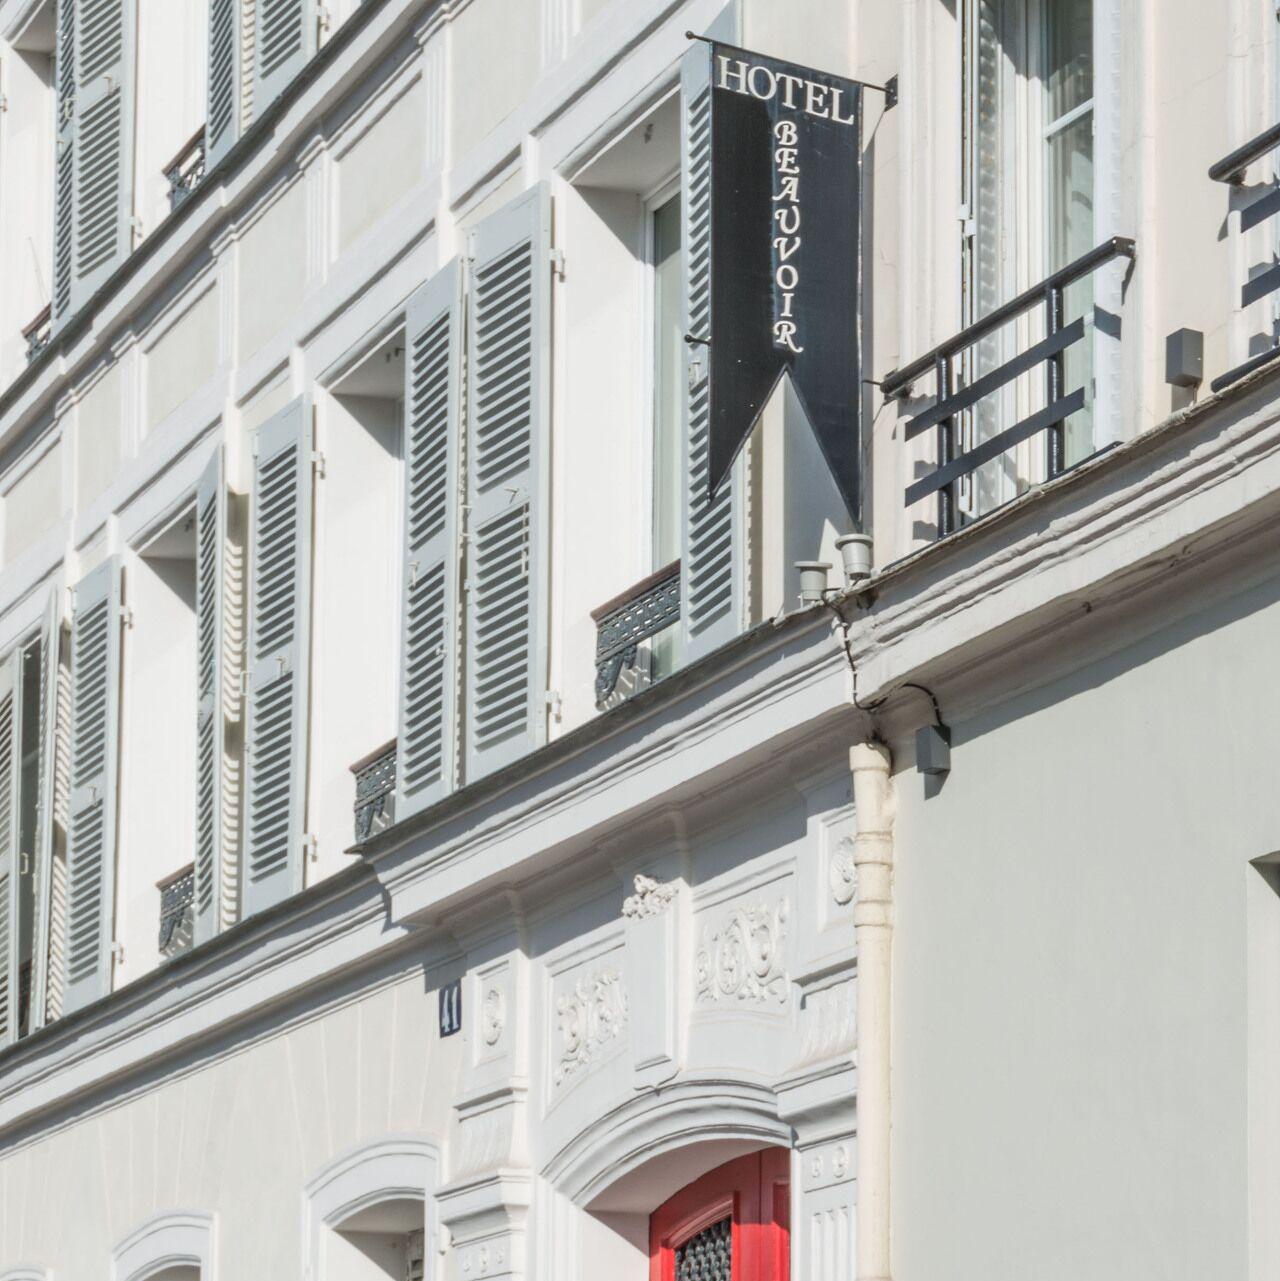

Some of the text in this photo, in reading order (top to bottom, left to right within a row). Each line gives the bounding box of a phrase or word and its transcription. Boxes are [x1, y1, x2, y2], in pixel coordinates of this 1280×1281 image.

[718, 55, 855, 126] HOTEL
[772, 119, 804, 354] BEAUVOIR
[442, 986, 459, 1033] 41
